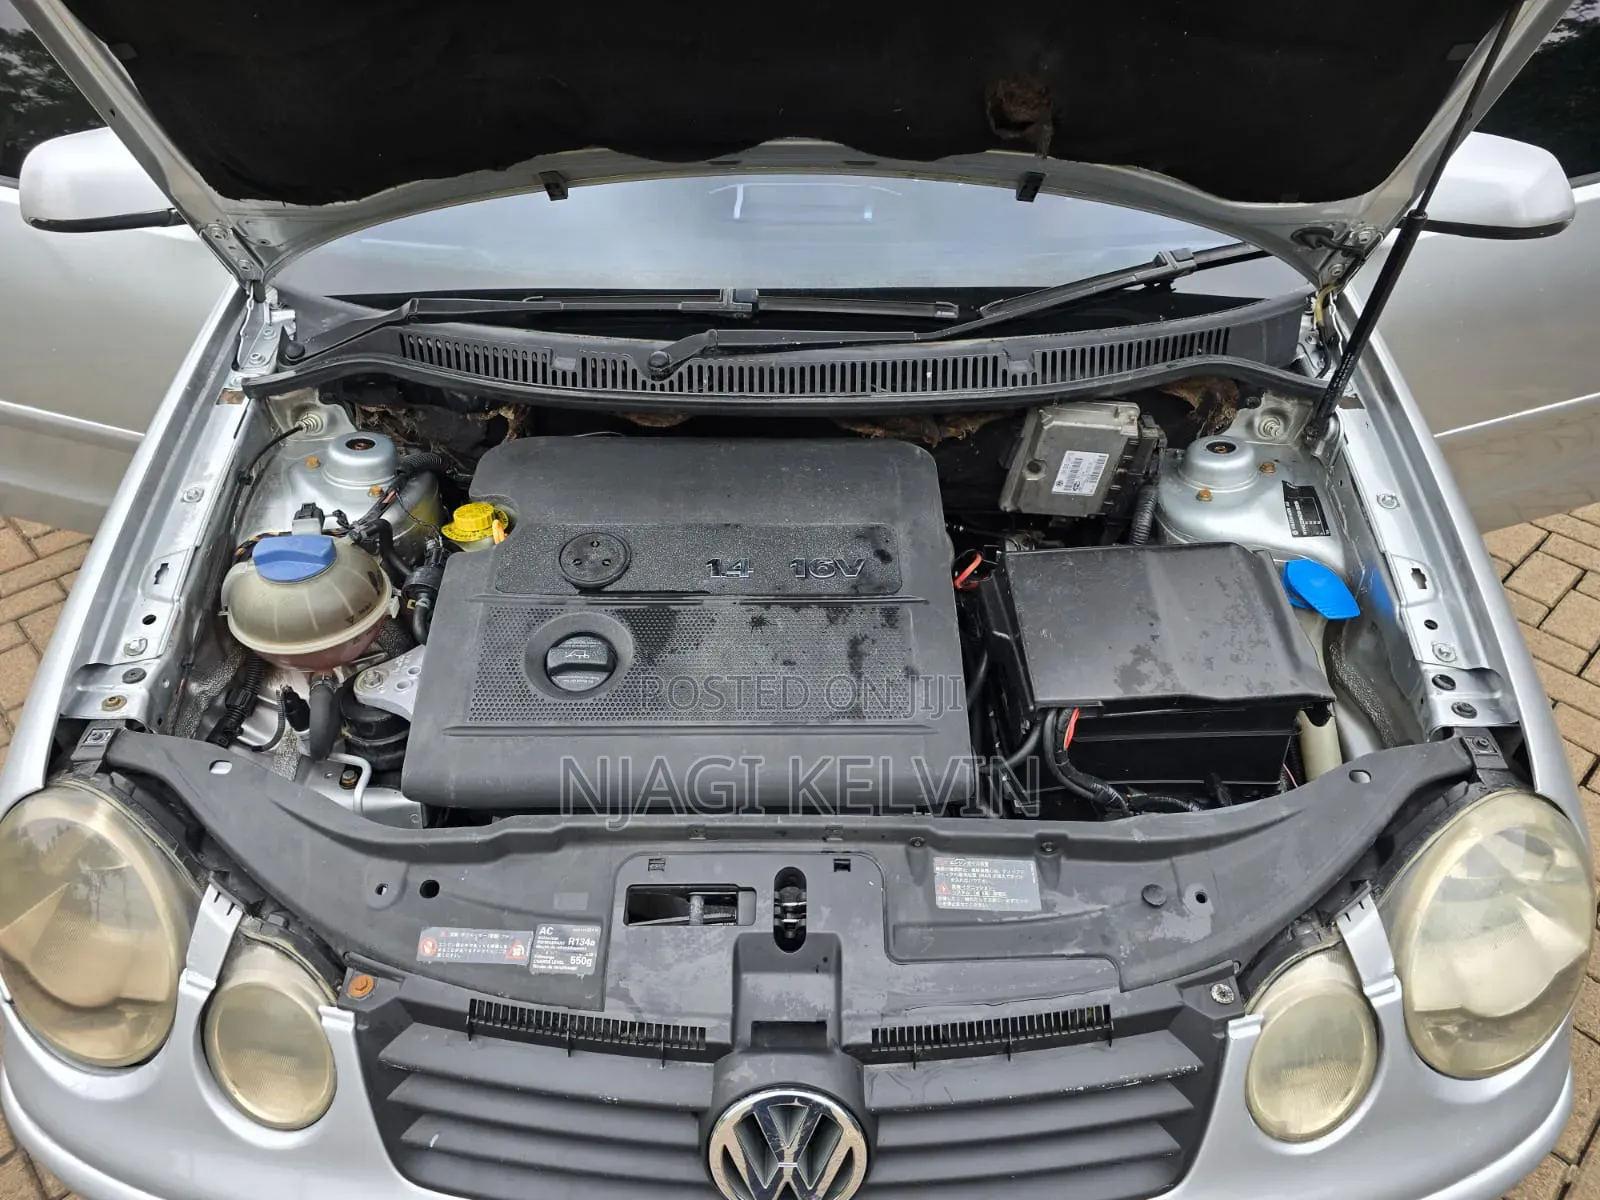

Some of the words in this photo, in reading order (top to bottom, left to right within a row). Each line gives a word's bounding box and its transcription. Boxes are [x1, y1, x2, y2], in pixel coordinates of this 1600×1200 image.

[706, 557, 754, 578] 1.4
[789, 557, 866, 578] 16V
[538, 926, 554, 936] AC
[568, 937, 596, 947] R134a
[570, 955, 593, 968] 550g
